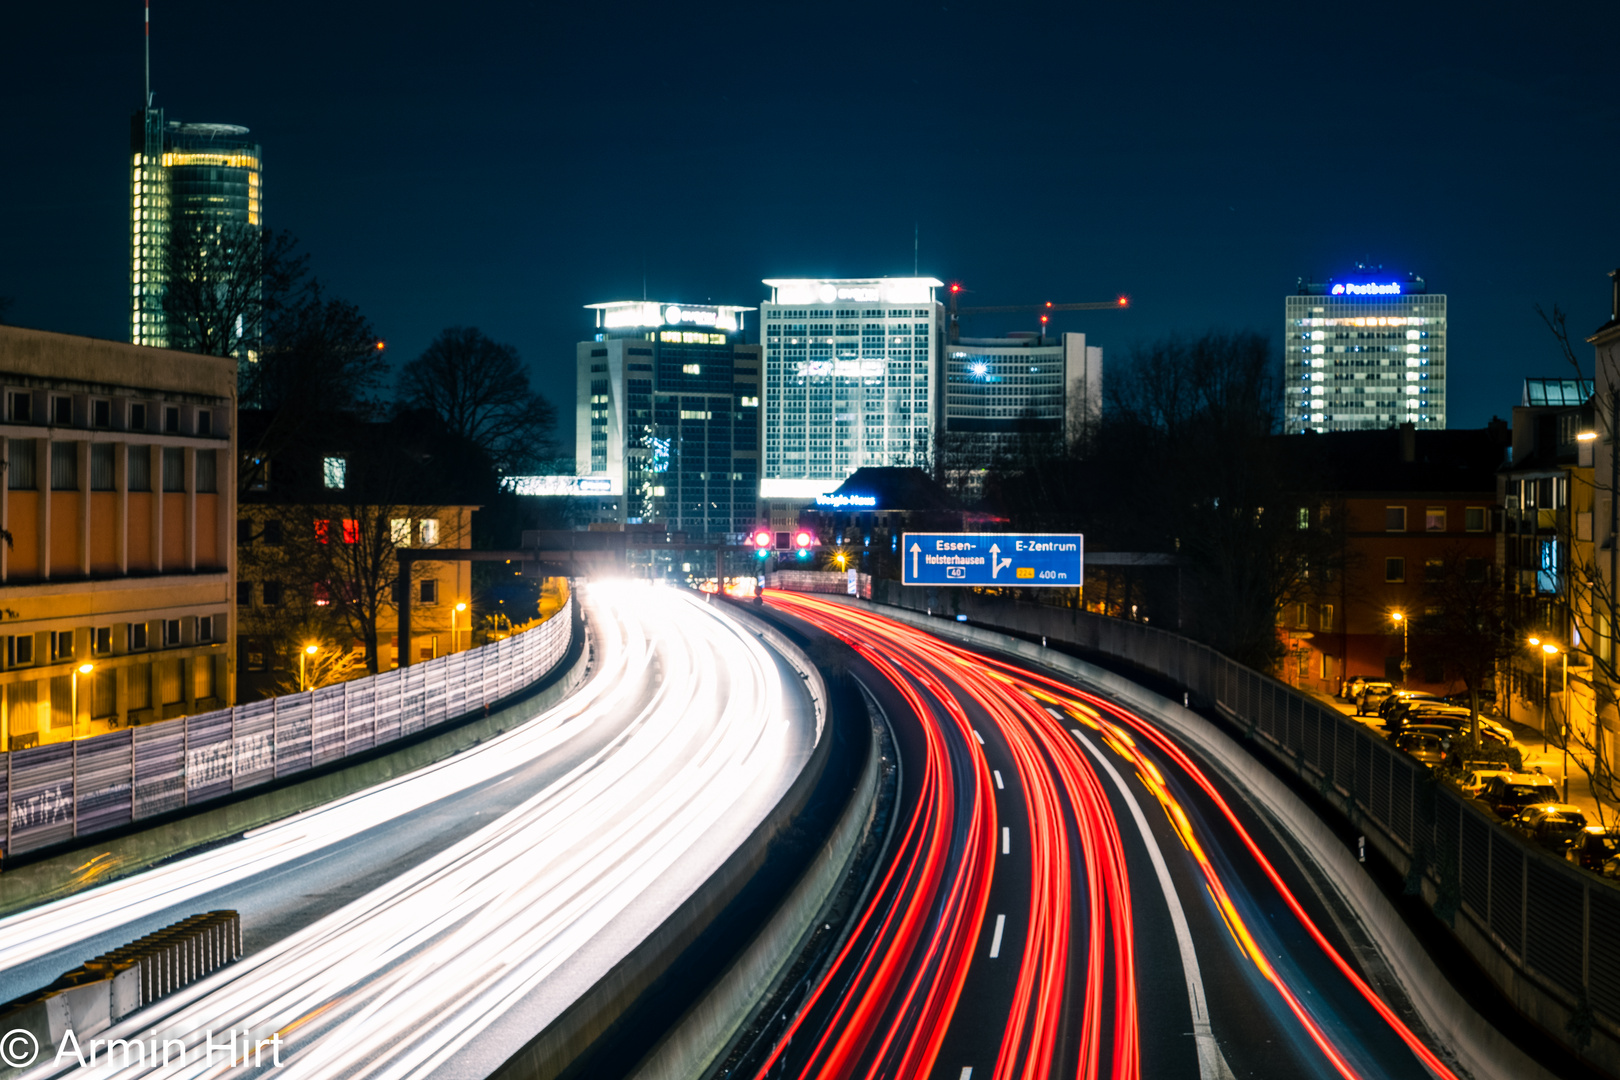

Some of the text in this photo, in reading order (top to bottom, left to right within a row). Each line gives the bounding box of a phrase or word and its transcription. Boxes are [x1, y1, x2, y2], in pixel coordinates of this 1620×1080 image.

[1346, 282, 1401, 295] Postbank
[936, 540, 977, 551] Essen-
[1015, 540, 1077, 552] E-Zentrum
[925, 554, 985, 565] Holsterhausen
[1039, 570, 1056, 579] 400
[11, 785, 70, 828] ANTIFA
